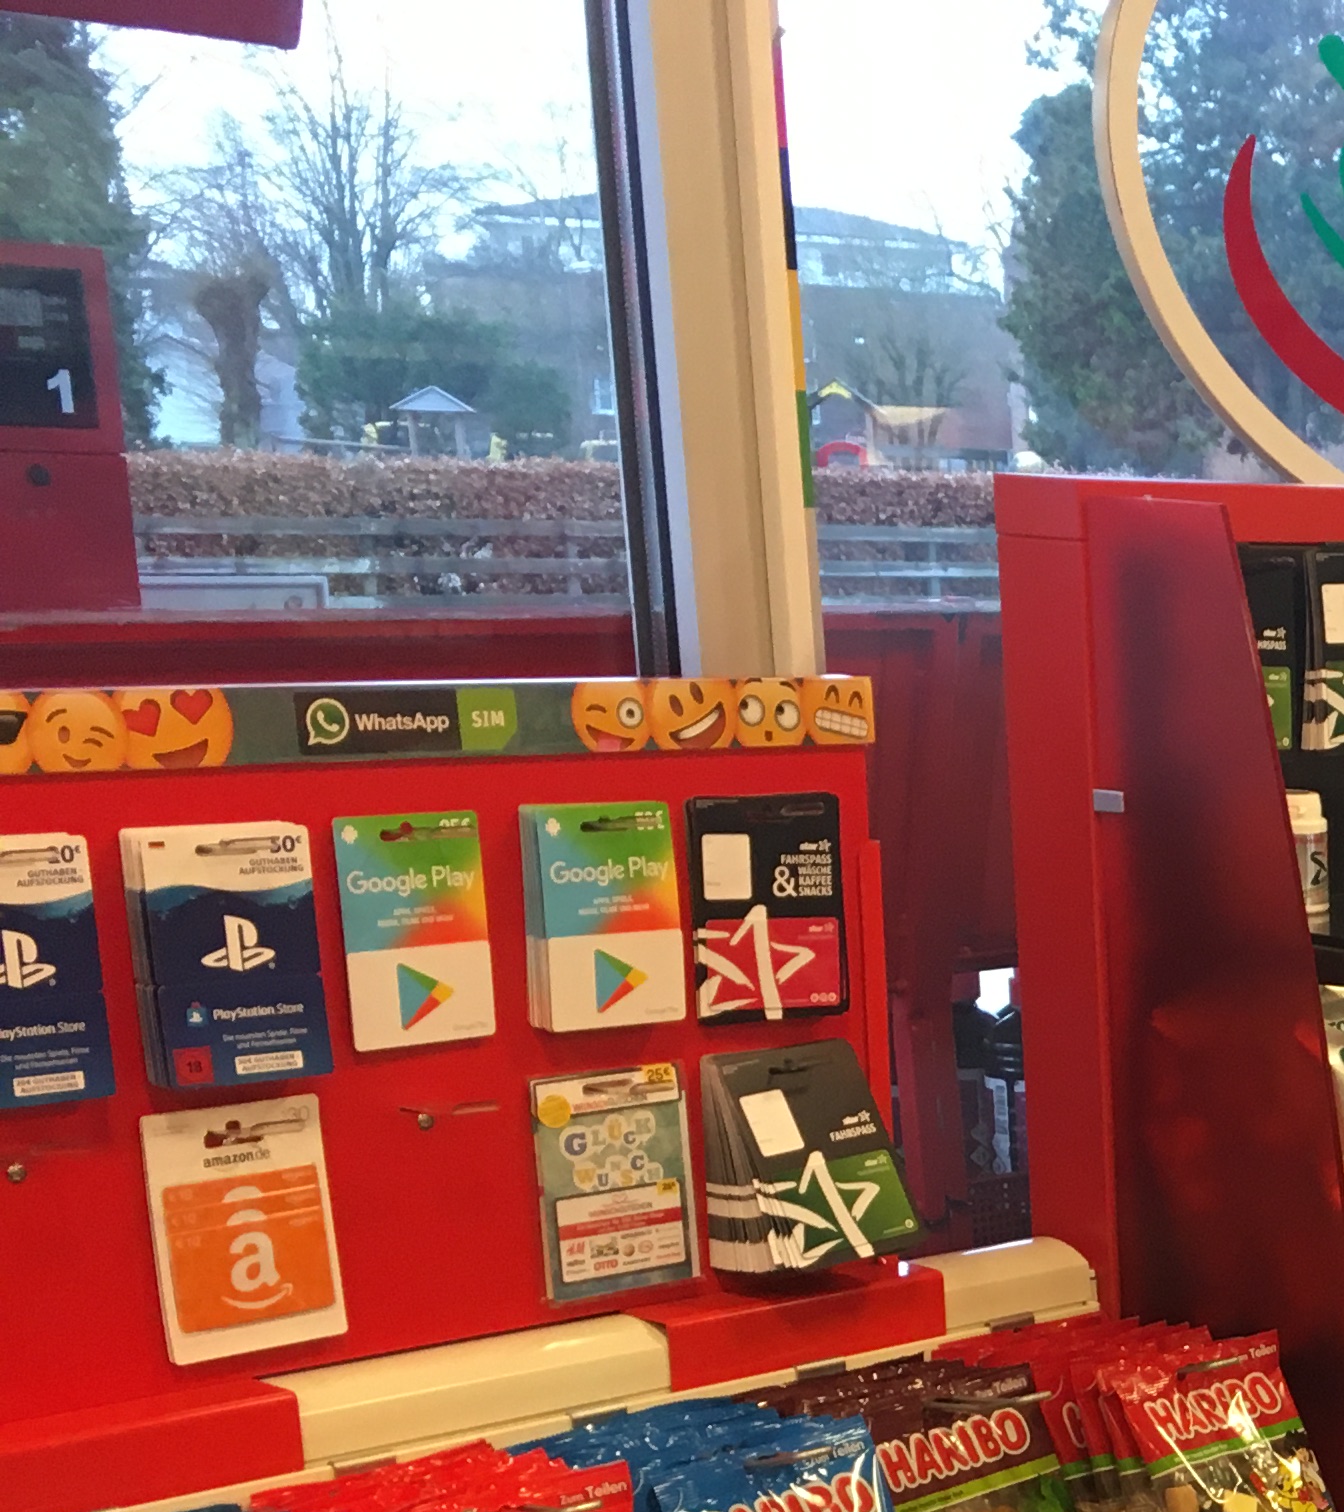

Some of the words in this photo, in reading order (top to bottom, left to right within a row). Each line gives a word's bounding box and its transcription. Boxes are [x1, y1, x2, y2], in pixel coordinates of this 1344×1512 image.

[47, 369, 74, 414] 1
[355, 711, 450, 734] WhatsApp
[470, 709, 506, 728] SIM
[249, 857, 298, 867] GUTHABEN
[781, 853, 832, 864] FAHRSPASS
[27, 867, 77, 879] GUTHABEN
[346, 869, 427, 897] Google
[432, 866, 475, 890] Play
[549, 861, 625, 887] Google
[628, 857, 669, 882] Play
[773, 866, 797, 898] &
[798, 865, 832, 875] WÄSCHE
[799, 875, 832, 885] KAFFEE
[799, 886, 832, 896] SNACKS
[213, 1004, 274, 1021] PlayStation
[277, 1002, 304, 1014] Store
[57, 1021, 85, 1033] Store
[647, 1067, 671, 1082] 25€
[830, 1123, 877, 1142] FAHRSPASS
[202, 1145, 270, 1171] amazon.de
[1144, 1372, 1283, 1443] HARIBO
[875, 1408, 1030, 1493] HARIBO
[586, 1481, 627, 1498] Teilen
